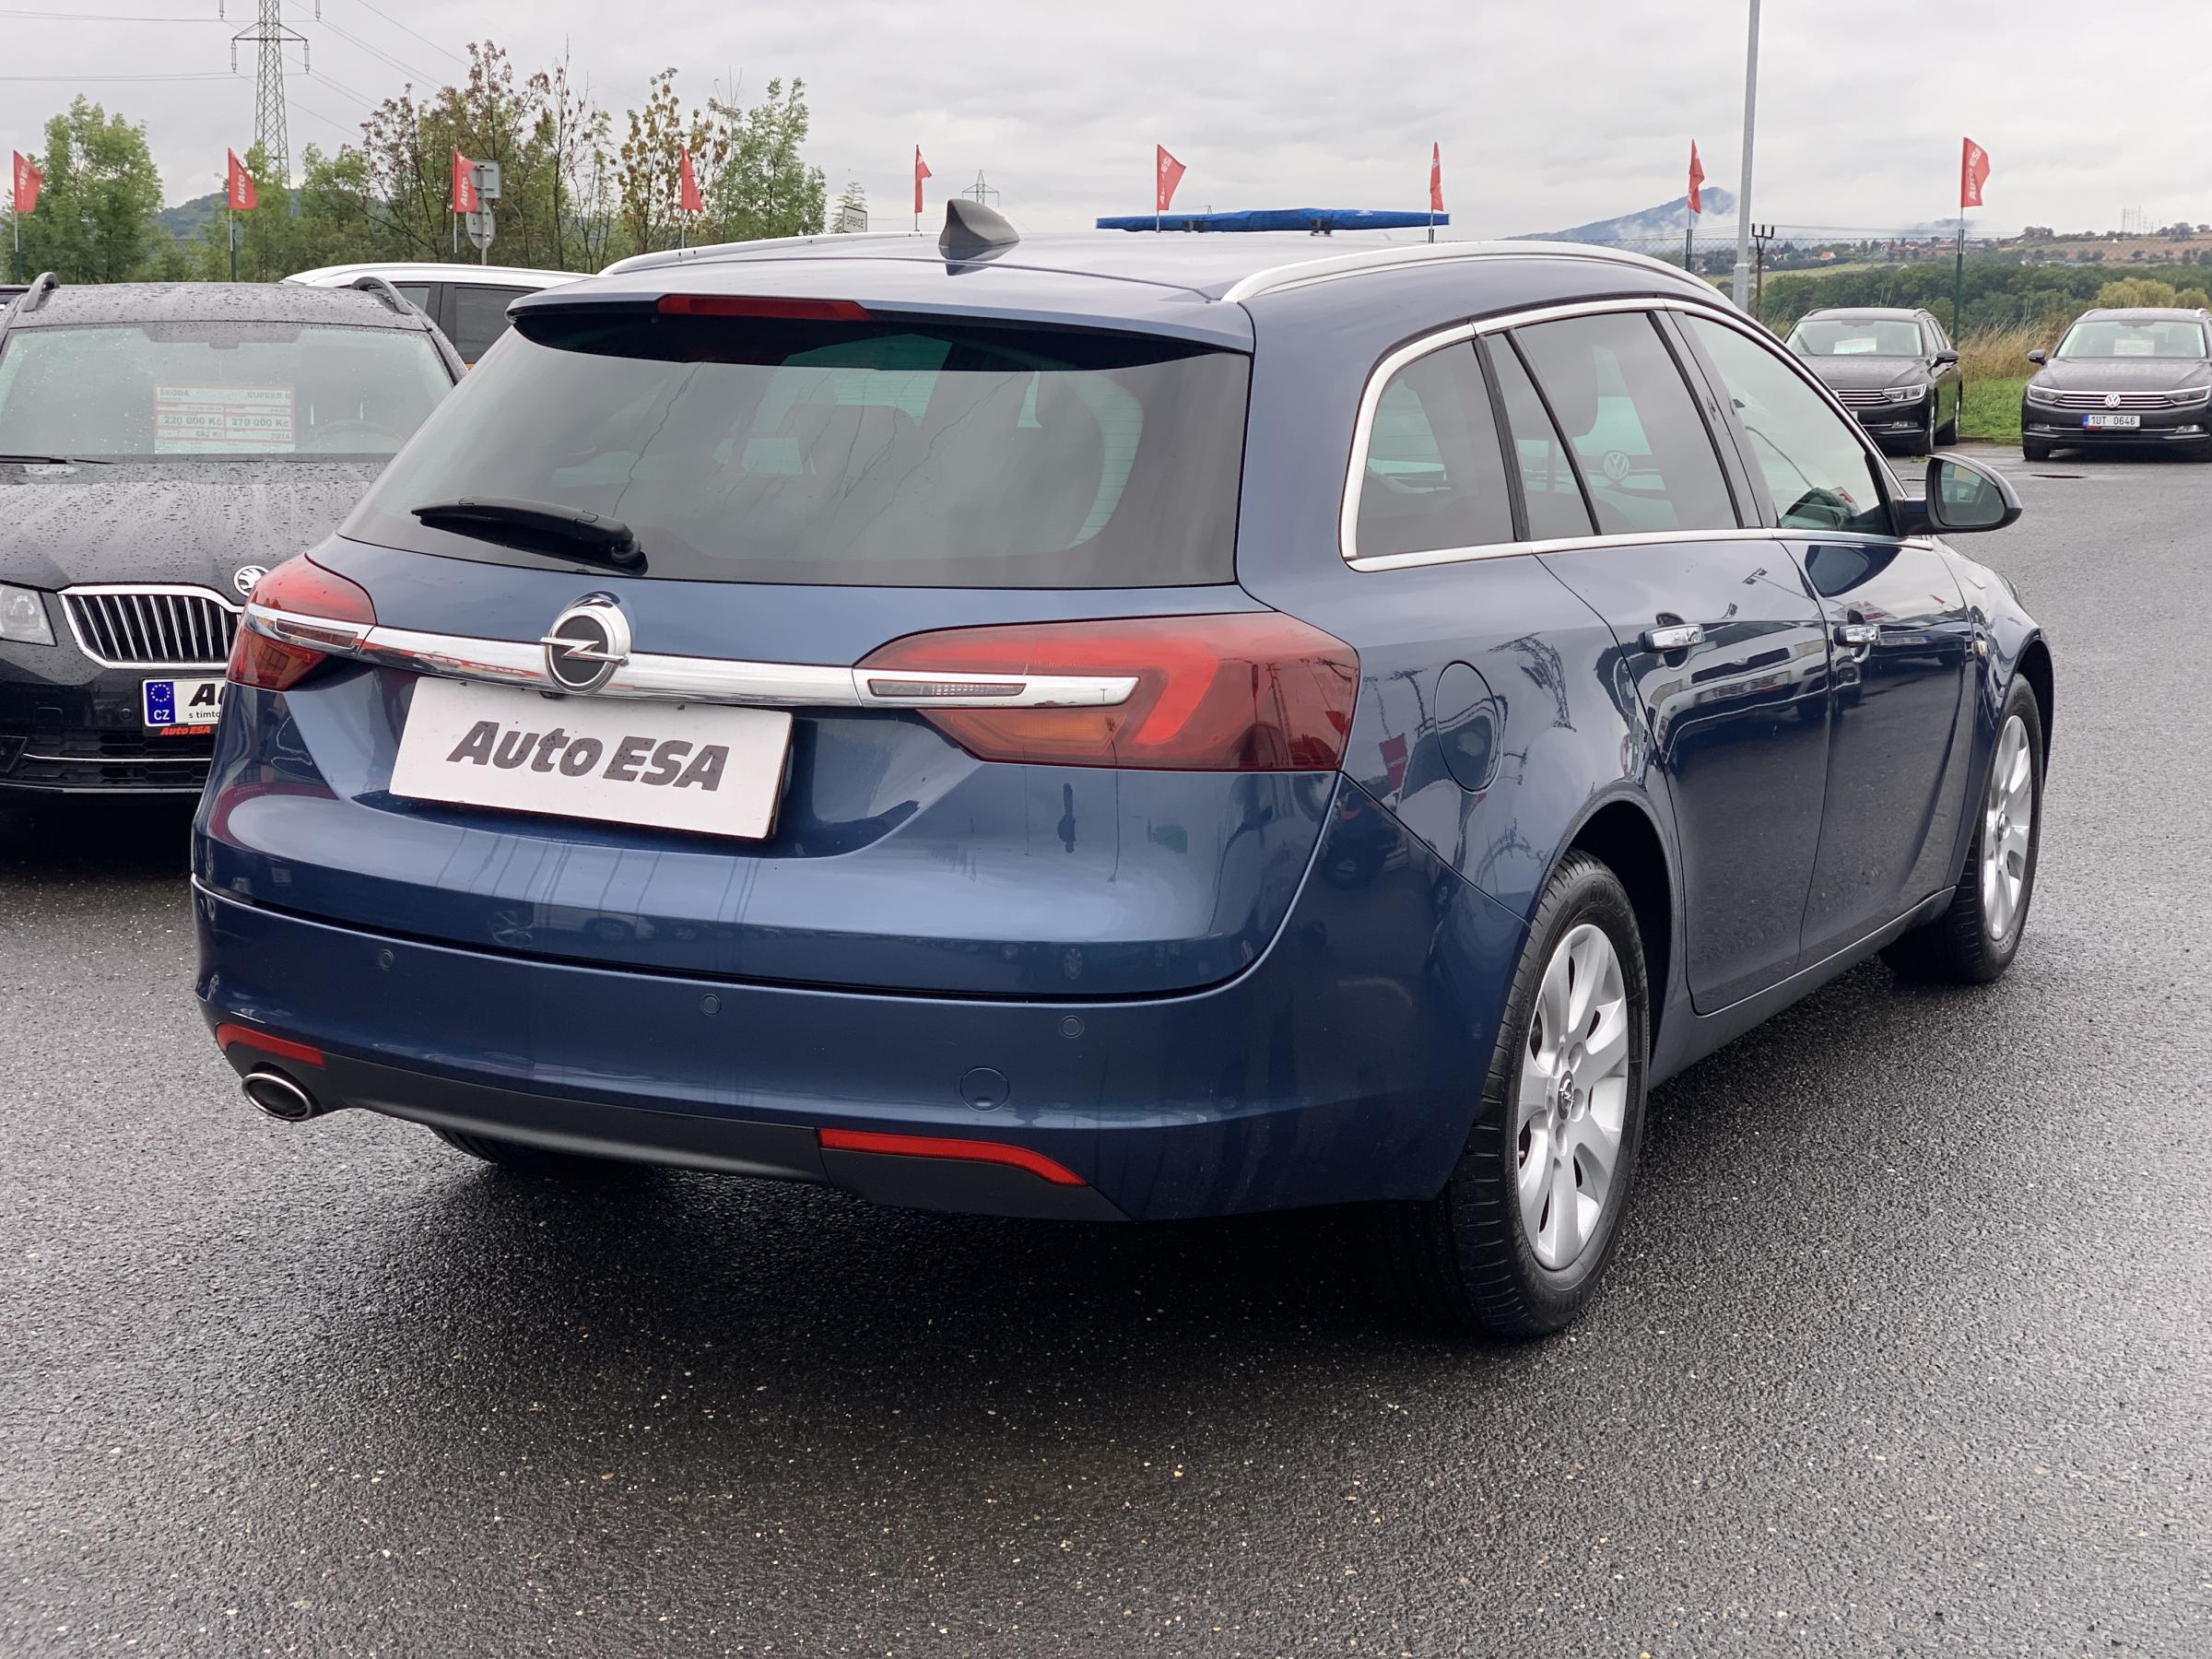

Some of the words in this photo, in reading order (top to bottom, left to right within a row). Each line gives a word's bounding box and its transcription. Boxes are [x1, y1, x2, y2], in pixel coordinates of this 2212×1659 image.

[238, 174, 246, 205] Auto
[461, 177, 469, 207] Auto
[164, 416, 183, 425] 220
[186, 417, 205, 425] 000
[231, 418, 251, 427] 270
[253, 418, 273, 427] 000
[275, 419, 289, 428] Kč
[2091, 416, 2107, 425] 1UT
[2113, 416, 2136, 426] 0646
[153, 709, 171, 721] CZ
[160, 726, 189, 735] Auto
[189, 725, 211, 735] ESA
[445, 720, 604, 778] Auto
[602, 735, 730, 793] ESA
